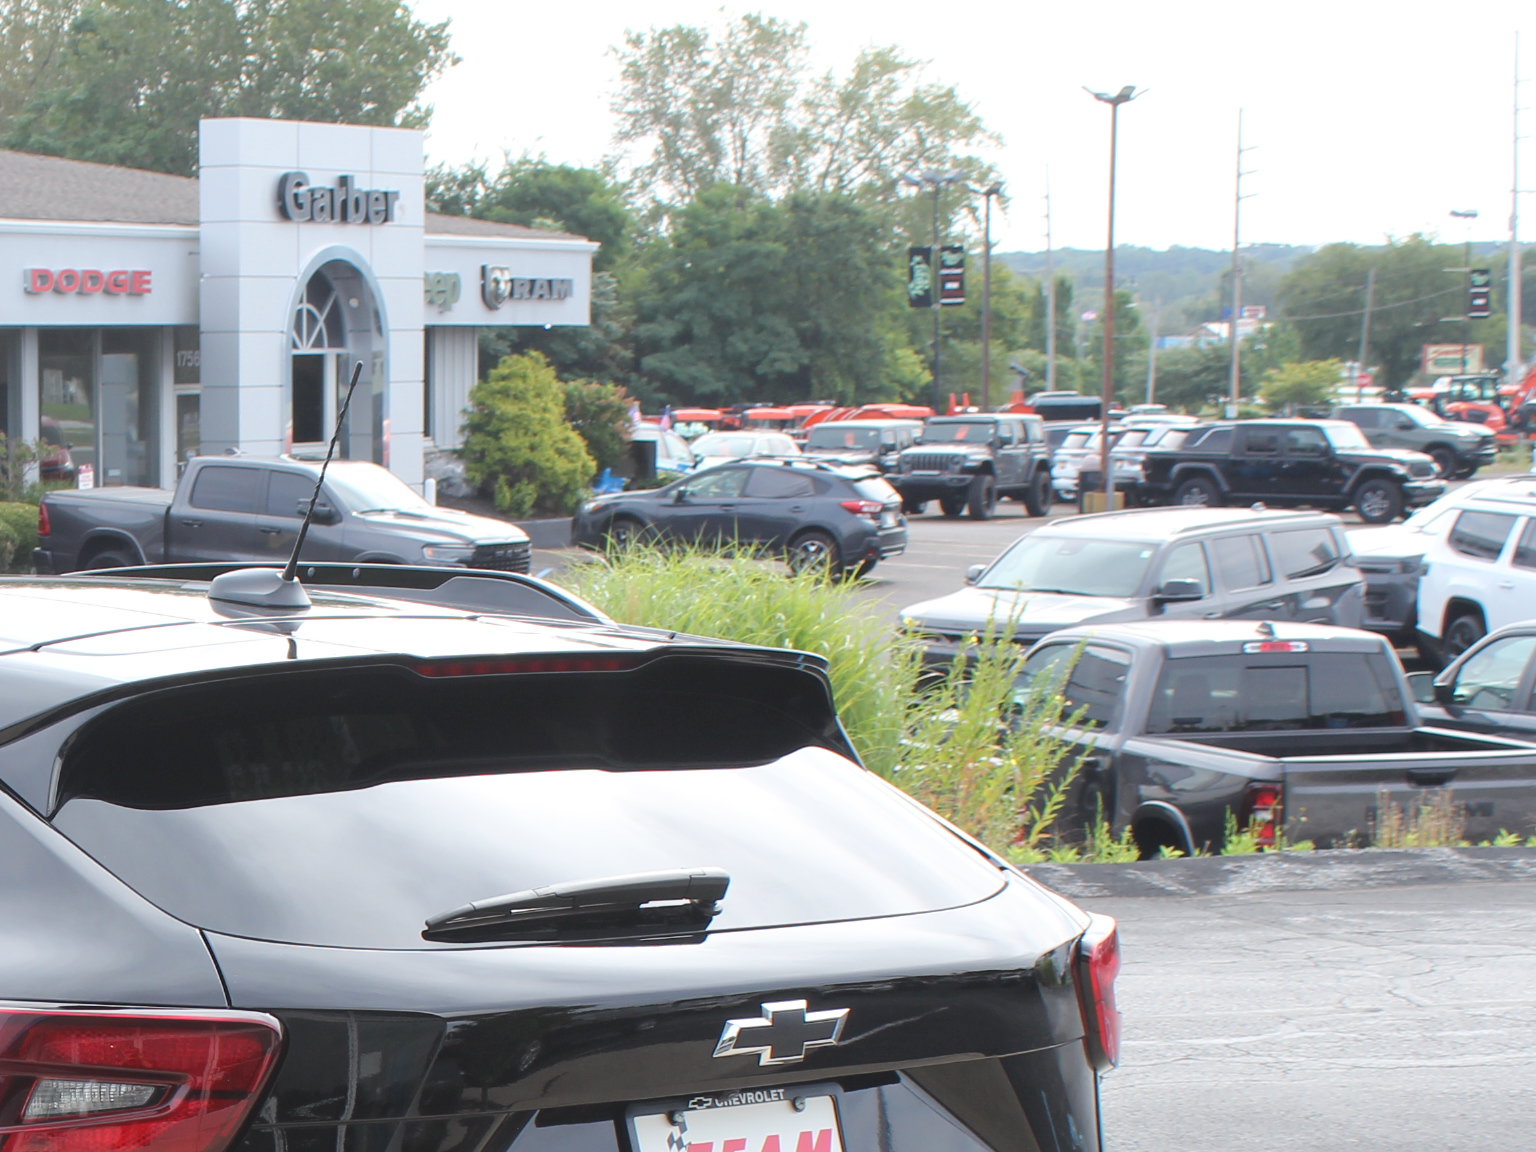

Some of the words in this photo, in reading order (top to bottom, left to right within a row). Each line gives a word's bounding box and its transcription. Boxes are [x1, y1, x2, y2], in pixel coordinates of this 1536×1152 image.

[278, 170, 400, 225] Garber
[24, 268, 153, 295] DODGE
[511, 278, 574, 300] RAM
[715, 1088, 785, 1107] CHEVROLET
